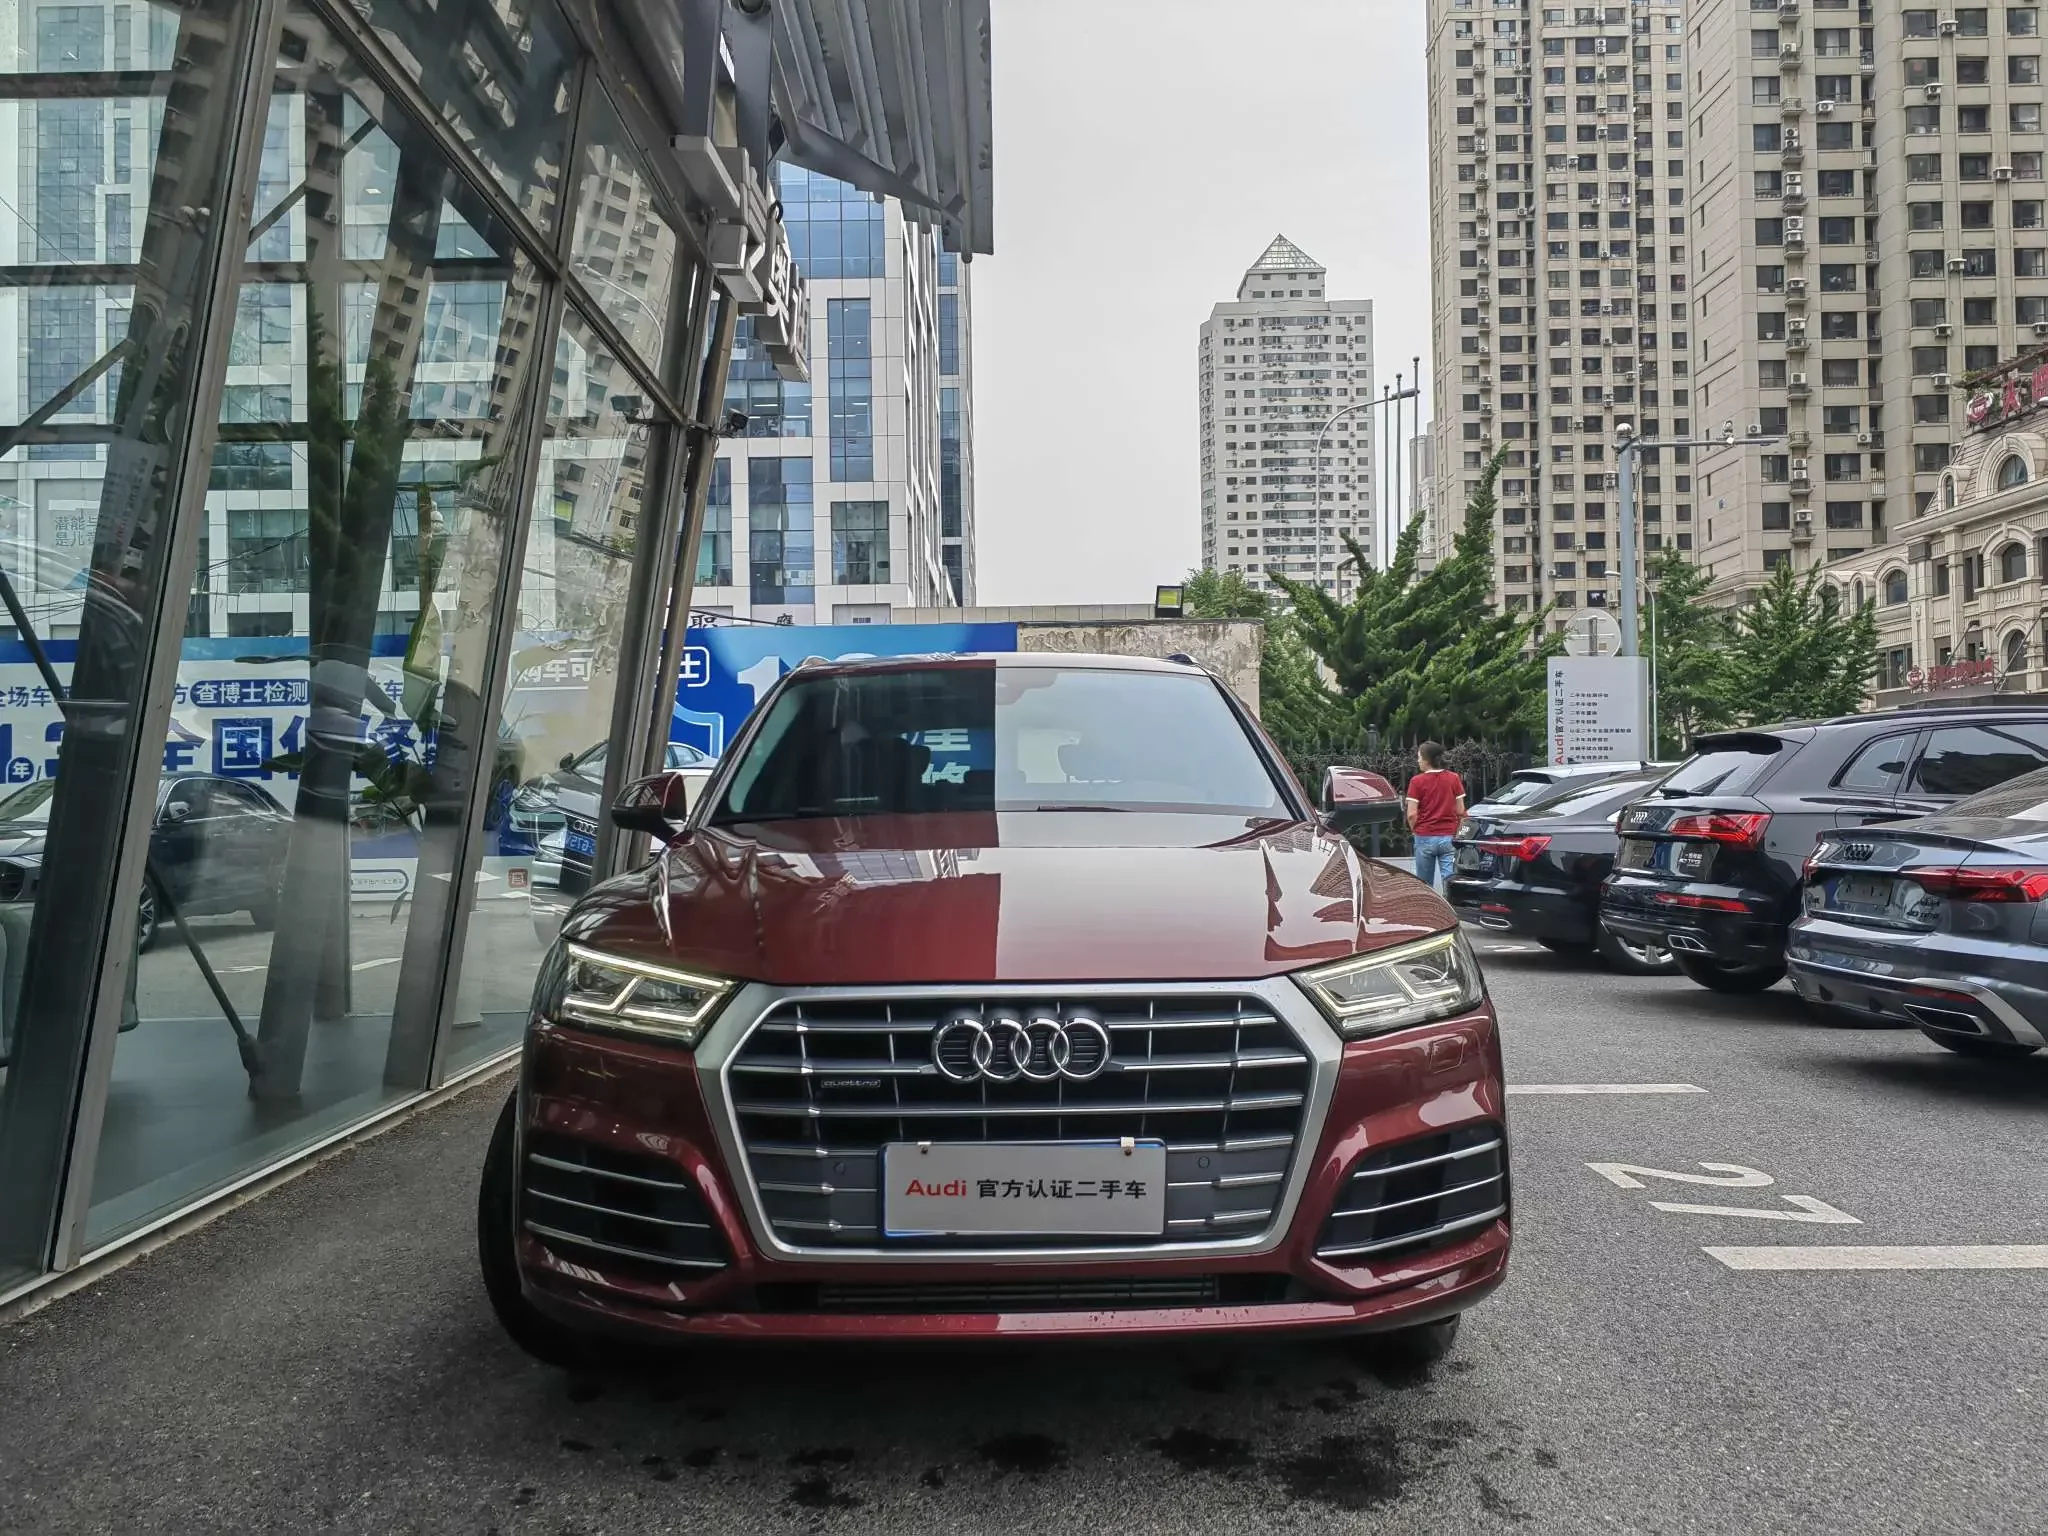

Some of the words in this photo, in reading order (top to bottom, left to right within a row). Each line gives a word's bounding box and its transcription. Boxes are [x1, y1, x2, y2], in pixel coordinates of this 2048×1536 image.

[0, 686, 52, 708] 场车
[195, 681, 309, 705] 查博士检测
[1554, 670, 1565, 733] 官方认证二手车
[1554, 735, 1564, 766] Audi
[905, 1179, 968, 1197] Audi
[977, 1178, 1148, 1199] 官方认证二手车
